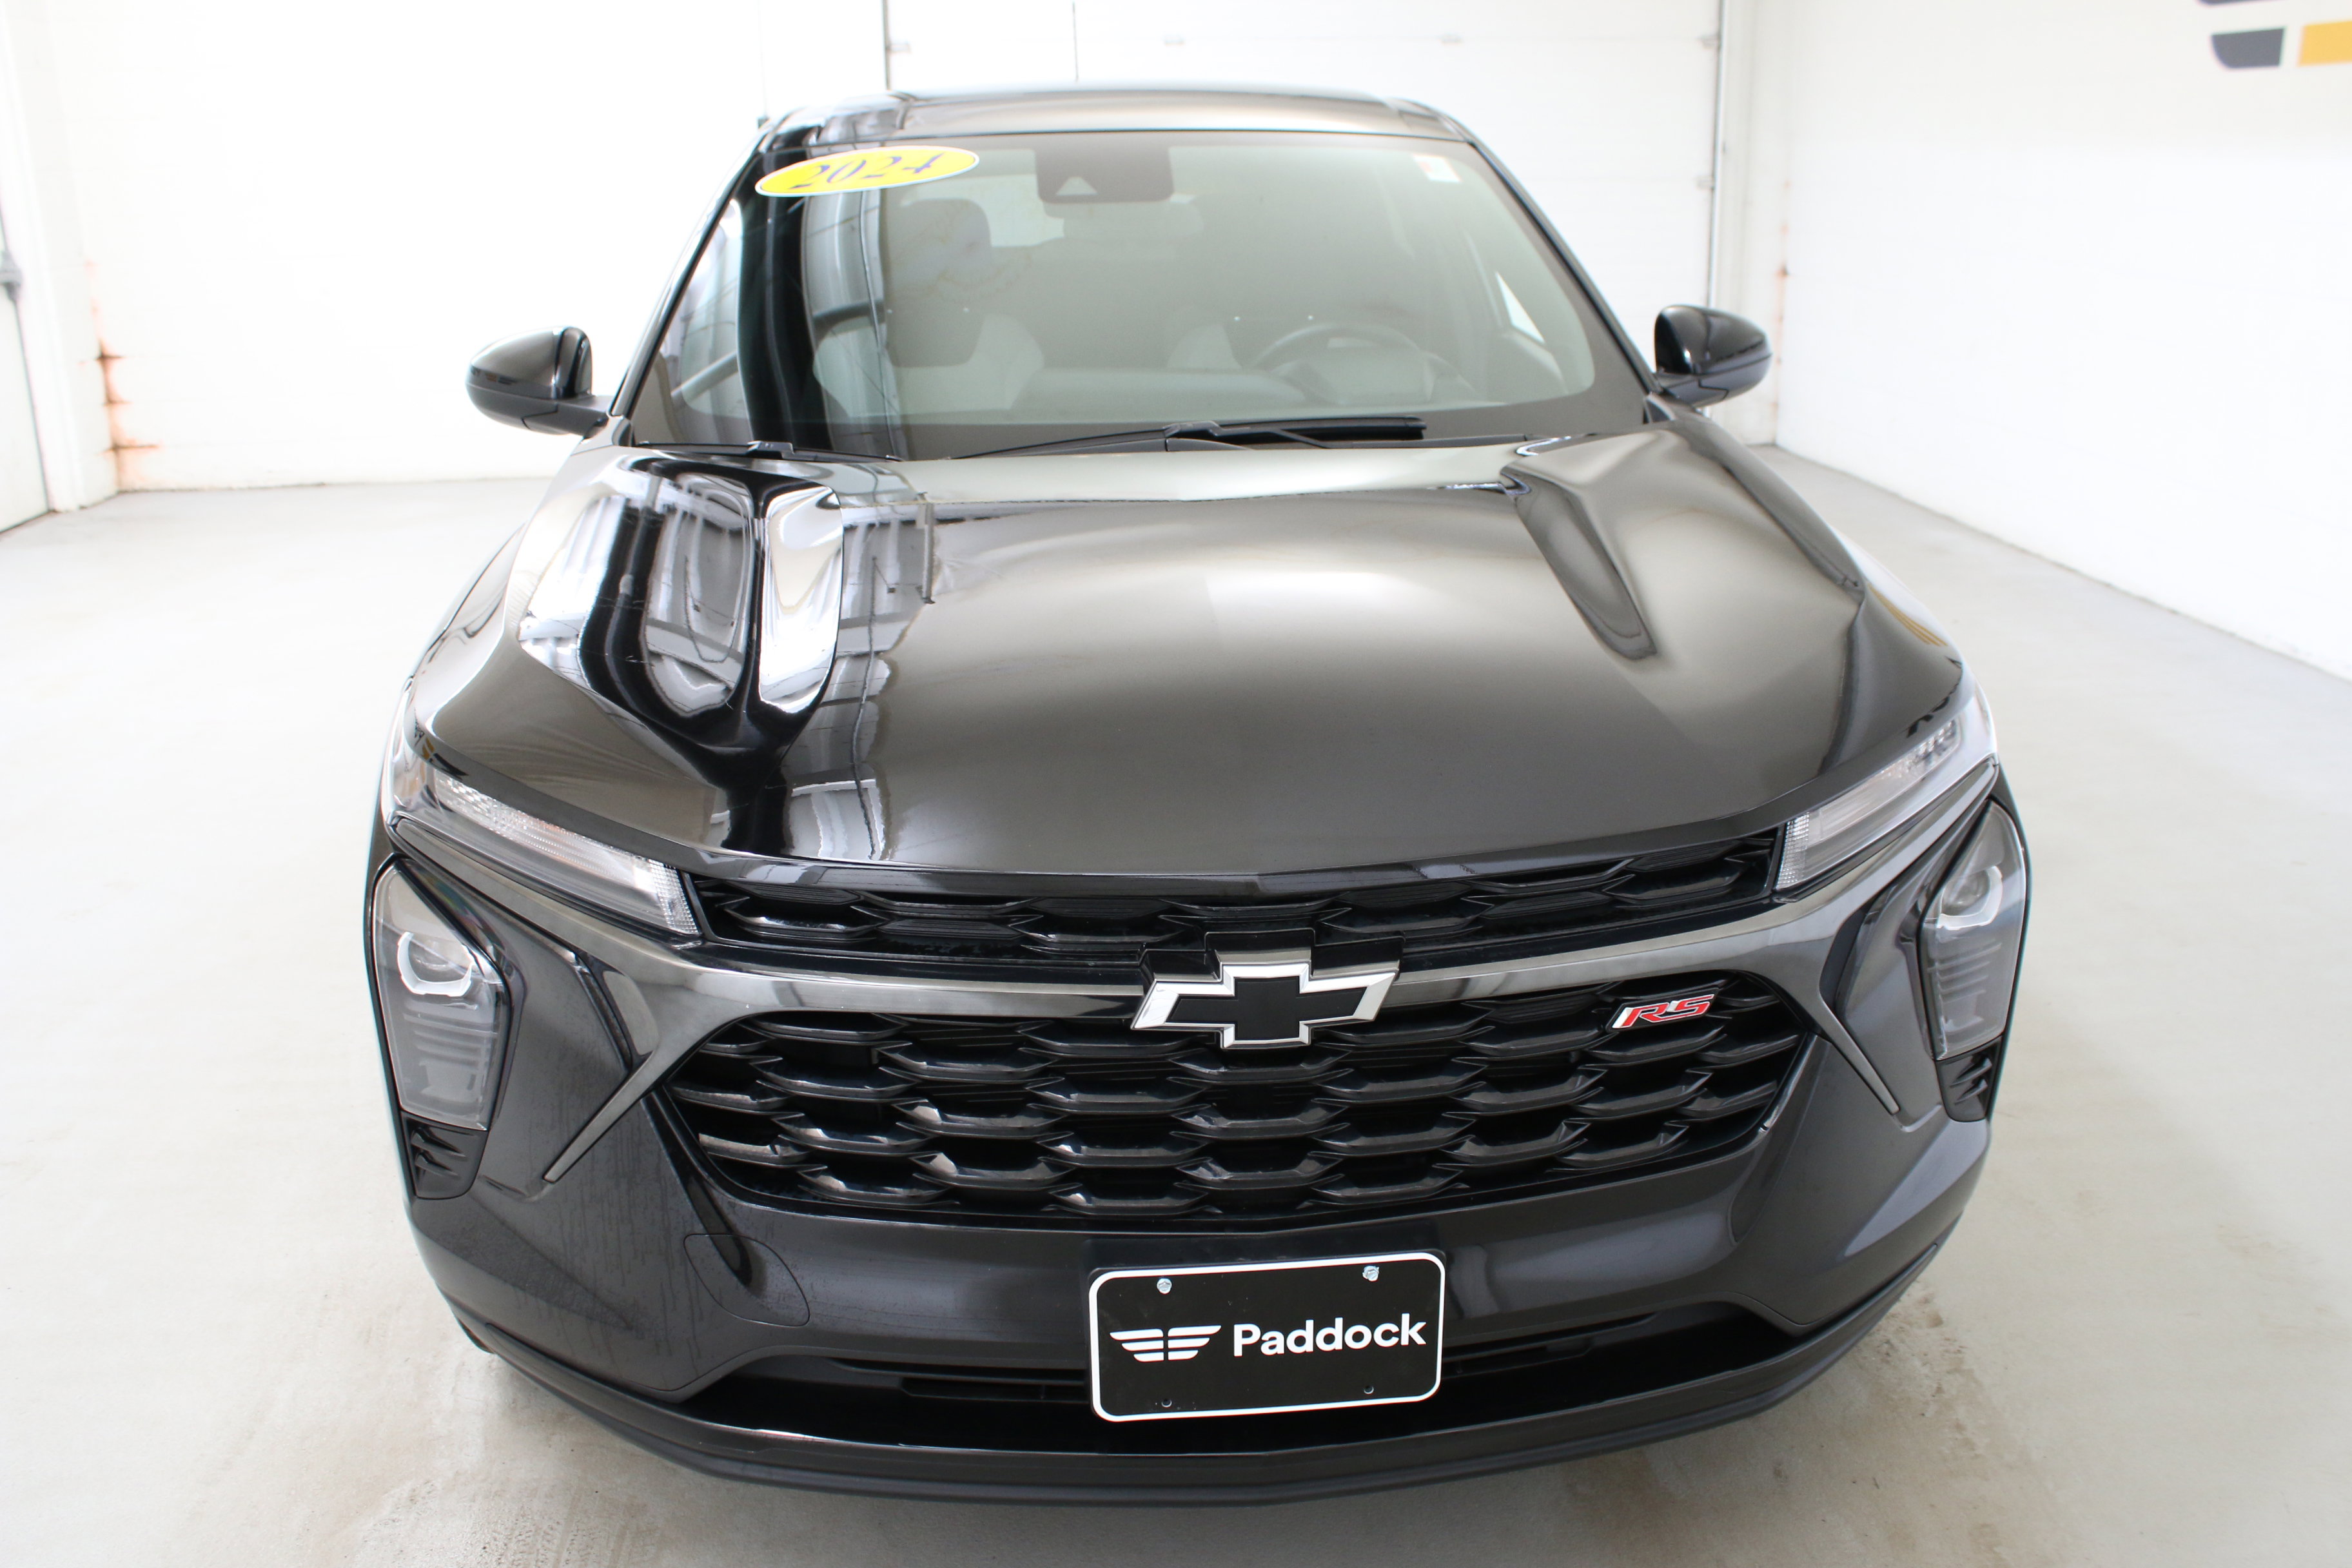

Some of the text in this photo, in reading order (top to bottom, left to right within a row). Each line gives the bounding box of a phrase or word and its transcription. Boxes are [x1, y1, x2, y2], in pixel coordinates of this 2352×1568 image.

[787, 151, 947, 191] 2024
[1612, 994, 1714, 1028] RS
[1233, 1313, 1427, 1357] Paddock
